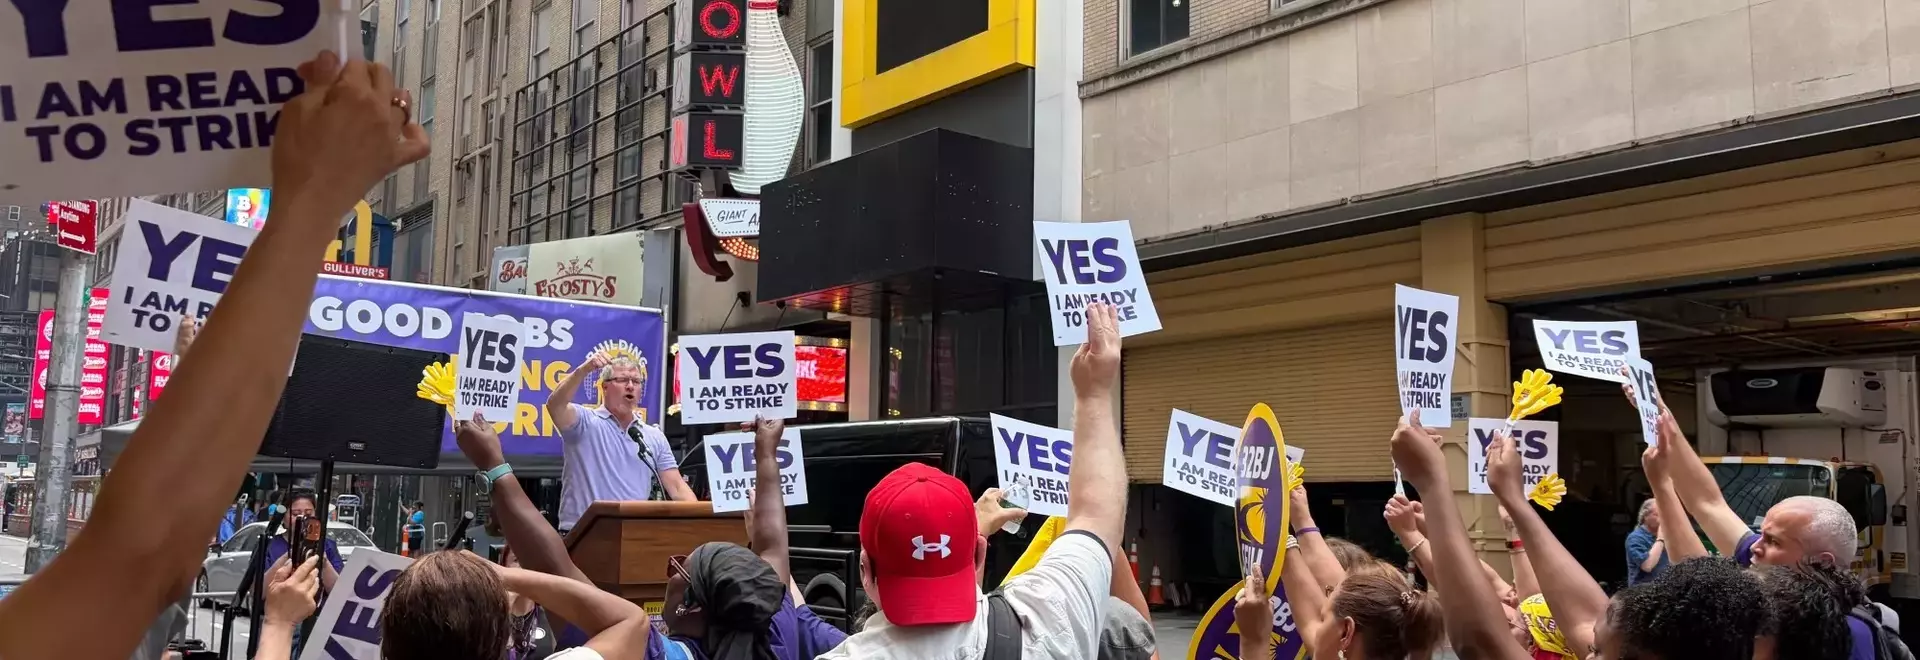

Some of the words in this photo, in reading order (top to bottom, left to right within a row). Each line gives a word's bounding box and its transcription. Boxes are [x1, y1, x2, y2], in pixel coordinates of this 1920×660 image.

[0, 86, 17, 121] I
[36, 78, 128, 119] AM
[146, 67, 305, 111] READ
[25, 123, 107, 162] TO
[125, 111, 283, 156] STRIK
[717, 209, 748, 222] GIANT
[138, 220, 248, 295] YE
[1040, 237, 1127, 285] YES
[124, 286, 134, 304] I
[140, 291, 189, 315] AM
[1055, 294, 1061, 310] I
[1065, 293, 1083, 309] AM
[131, 308, 171, 332] TO
[309, 296, 453, 339] GOOD
[1063, 311, 1082, 327] TO
[1397, 304, 1449, 364] YES
[1541, 327, 1629, 356] YES
[465, 326, 518, 374] YES
[686, 343, 785, 380] YES
[1557, 353, 1580, 363] AM
[1583, 357, 1625, 367] READ
[1410, 371, 1446, 390] READY
[1555, 359, 1575, 368] TO
[1580, 364, 1622, 376] STRIK
[460, 376, 463, 390] I
[463, 376, 477, 391] AM
[478, 378, 515, 395] READY
[690, 387, 694, 398] I
[700, 386, 726, 398] AM
[732, 383, 789, 397] READY
[1630, 366, 1657, 405] YE
[461, 392, 471, 406] TO
[472, 393, 508, 408] STRIKE
[696, 399, 720, 411] TO
[725, 395, 782, 410] STRIKE
[997, 427, 1073, 475] YES
[1177, 421, 1237, 471] YE
[1172, 458, 1177, 468] I
[1181, 462, 1204, 477] AM
[1208, 470, 1236, 488] REA
[1240, 446, 1275, 480] 32BJ
[1475, 463, 1478, 472] I
[717, 480, 721, 490] I
[725, 478, 746, 489] AM
[723, 490, 742, 500] TO
[1004, 470, 1008, 481] I
[1037, 477, 1069, 492] REA
[1177, 470, 1197, 484] TO
[1201, 481, 1235, 498] STRI
